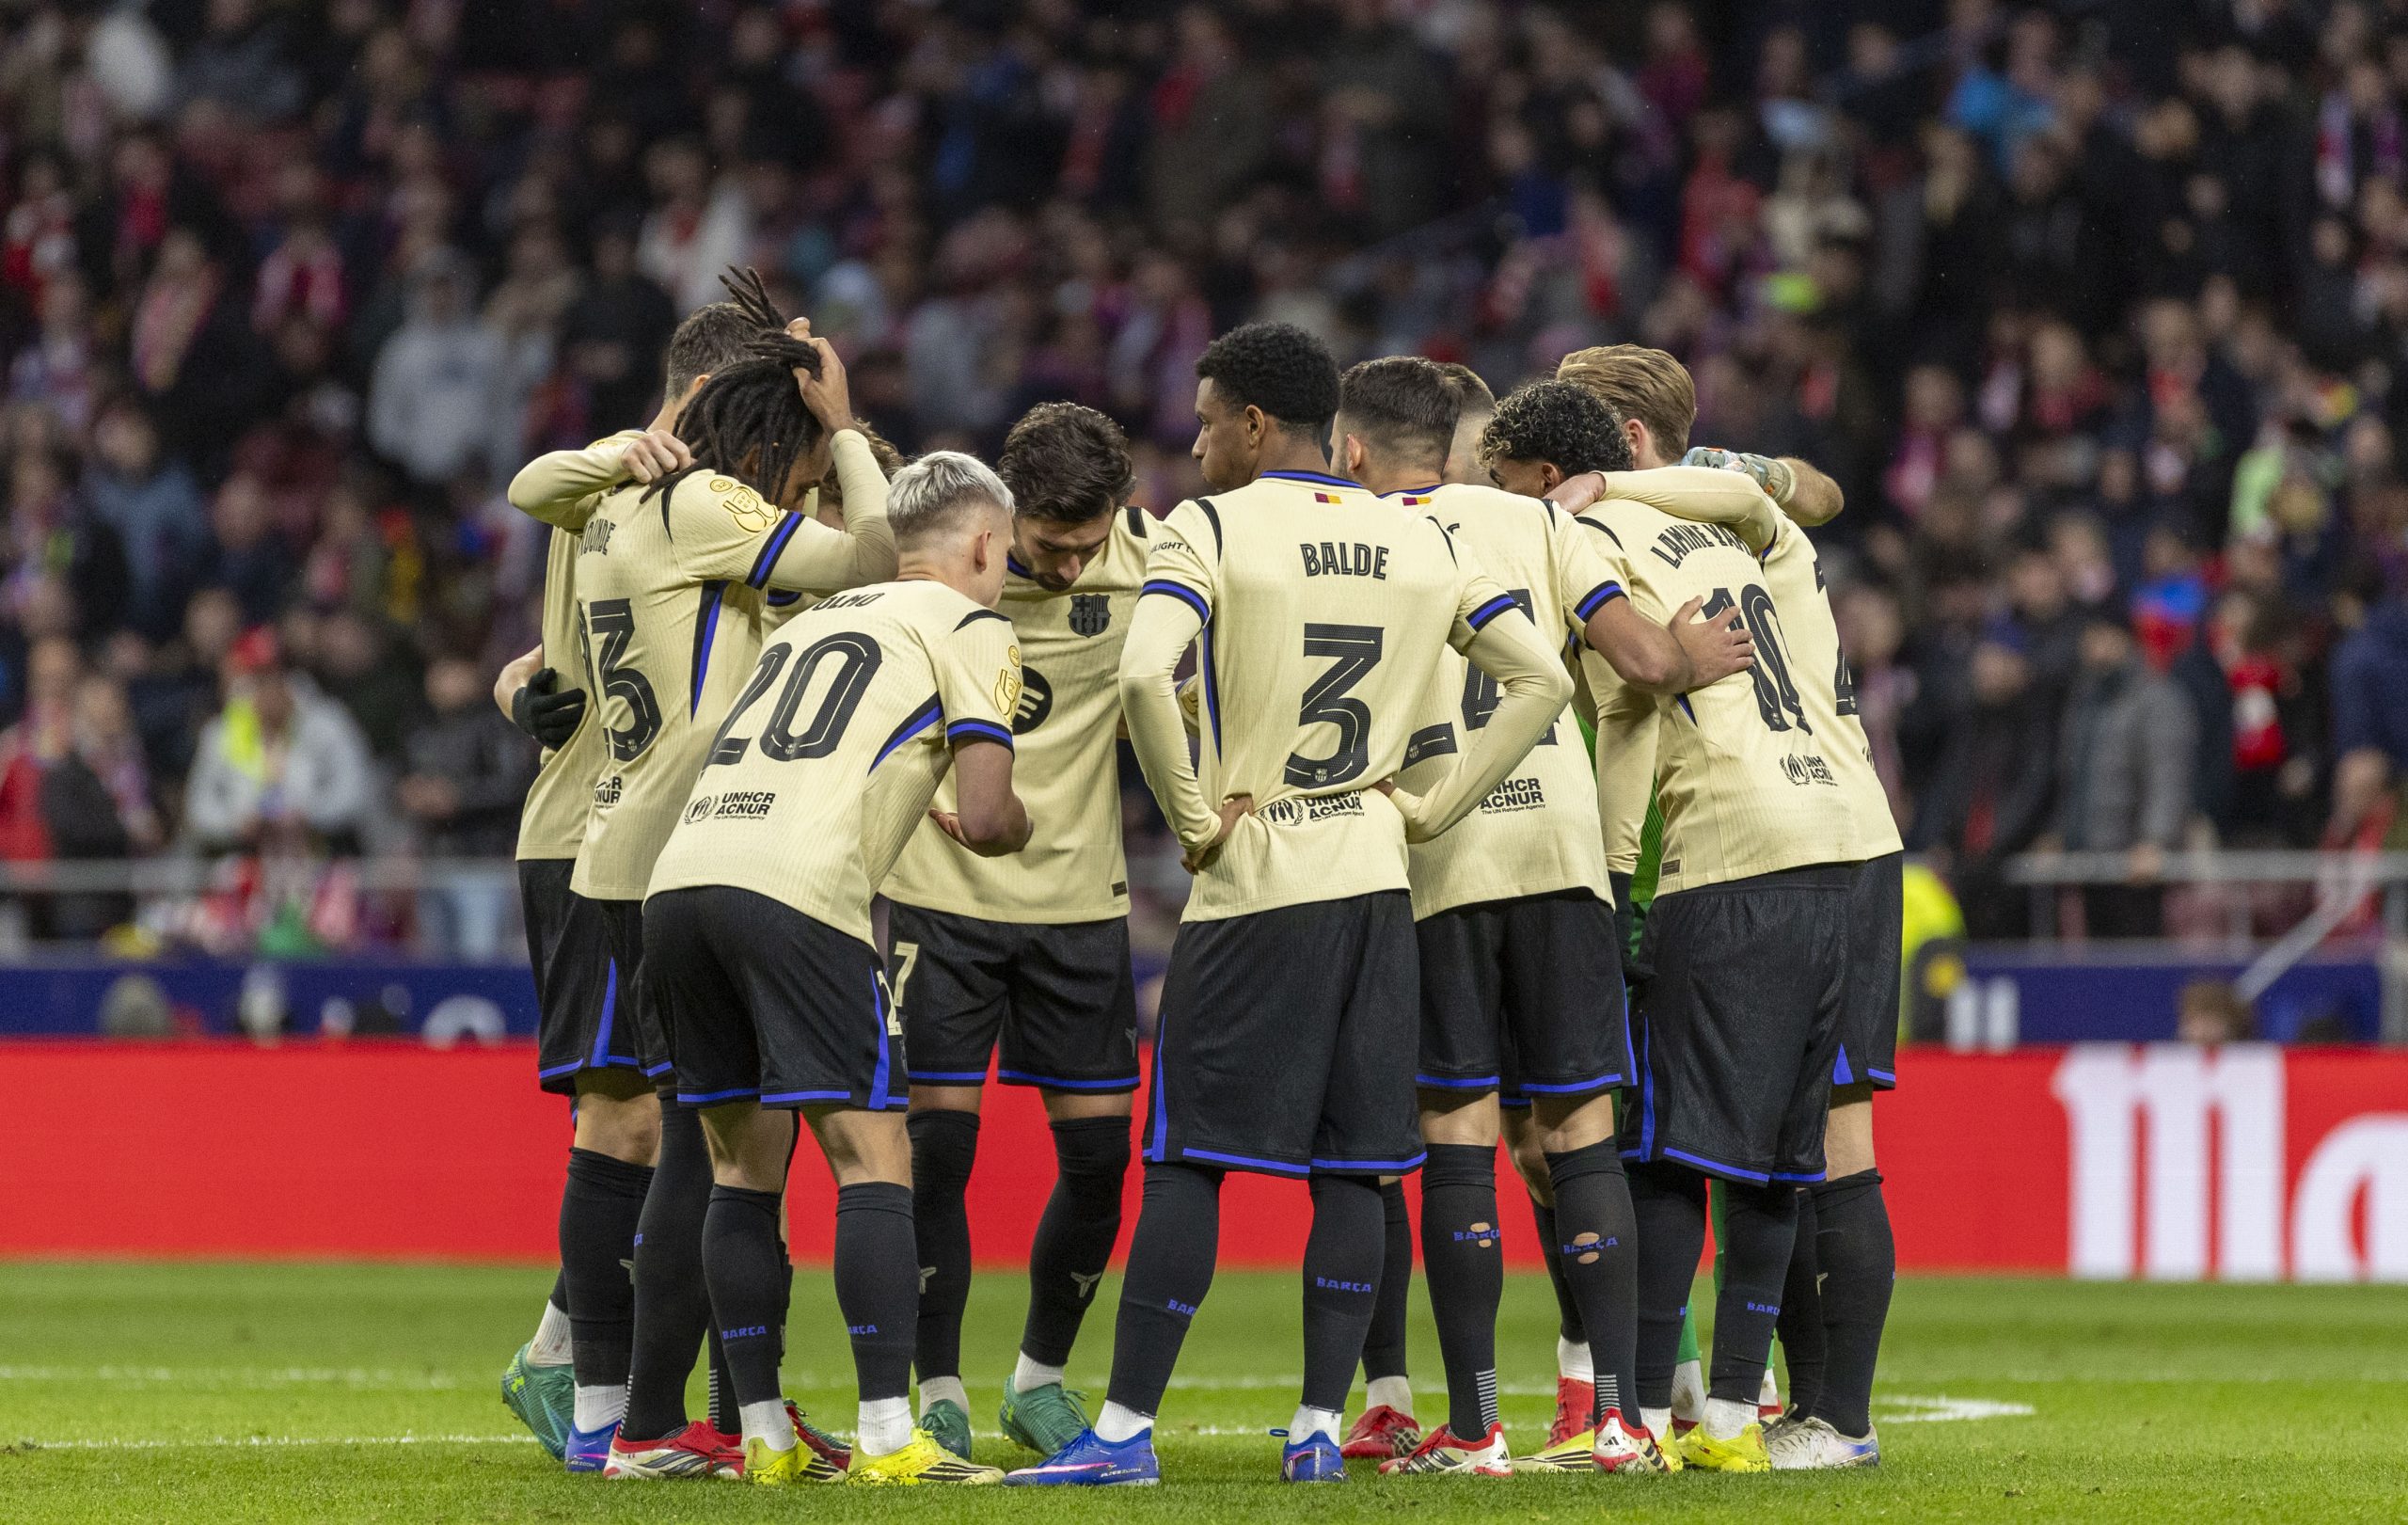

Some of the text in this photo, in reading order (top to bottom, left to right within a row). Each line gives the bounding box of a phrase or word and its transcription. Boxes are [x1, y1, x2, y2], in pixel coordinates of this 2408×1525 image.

[1300, 542, 1389, 580] BALDE
[1650, 524, 1715, 569] LAMINE
[812, 592, 885, 611] OLMO
[1702, 583, 1813, 736] 10
[699, 631, 882, 780] 20
[1283, 623, 1385, 789] 3
[722, 792, 775, 803] UNHCR
[1480, 791, 1544, 810] ACNUR
[1492, 777, 1542, 794] NHCR
[715, 802, 770, 816] ACNUR
[1309, 796, 1363, 819] ACNUR
[895, 942, 919, 1007] 7
